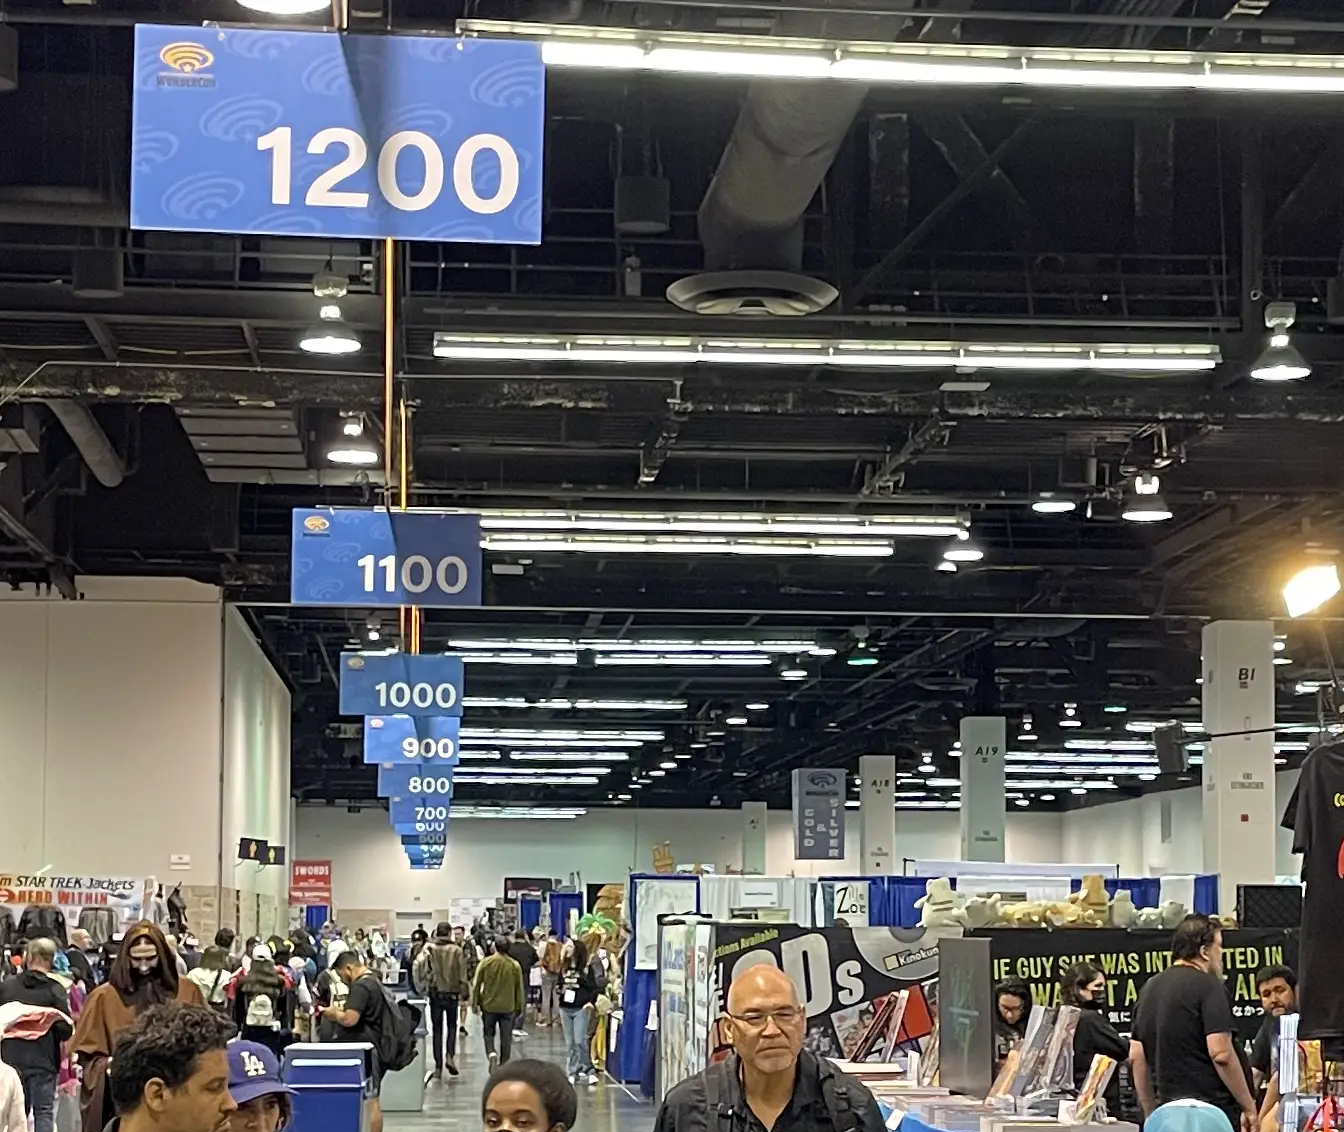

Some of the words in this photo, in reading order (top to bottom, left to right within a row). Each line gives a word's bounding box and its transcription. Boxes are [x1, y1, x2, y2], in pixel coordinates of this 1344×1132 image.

[256, 126, 519, 215] 1200
[357, 553, 468, 594] 1100
[374, 681, 457, 709] 1000
[401, 737, 454, 758] 900
[975, 746, 999, 756] A19
[408, 776, 450, 794] 800
[414, 806, 447, 821] 700
[804, 808, 815, 847] GOLD
[16, 875, 46, 888] STAR
[49, 876, 83, 889] TREK
[84, 877, 135, 892] Jackets
[18, 890, 52, 903] HERO
[57, 890, 109, 905] WITHIN
[1016, 956, 1054, 979] GUY
[1100, 952, 1140, 975] WAS
[1265, 946, 1284, 966] IN
[240, 1050, 267, 1077] LA
